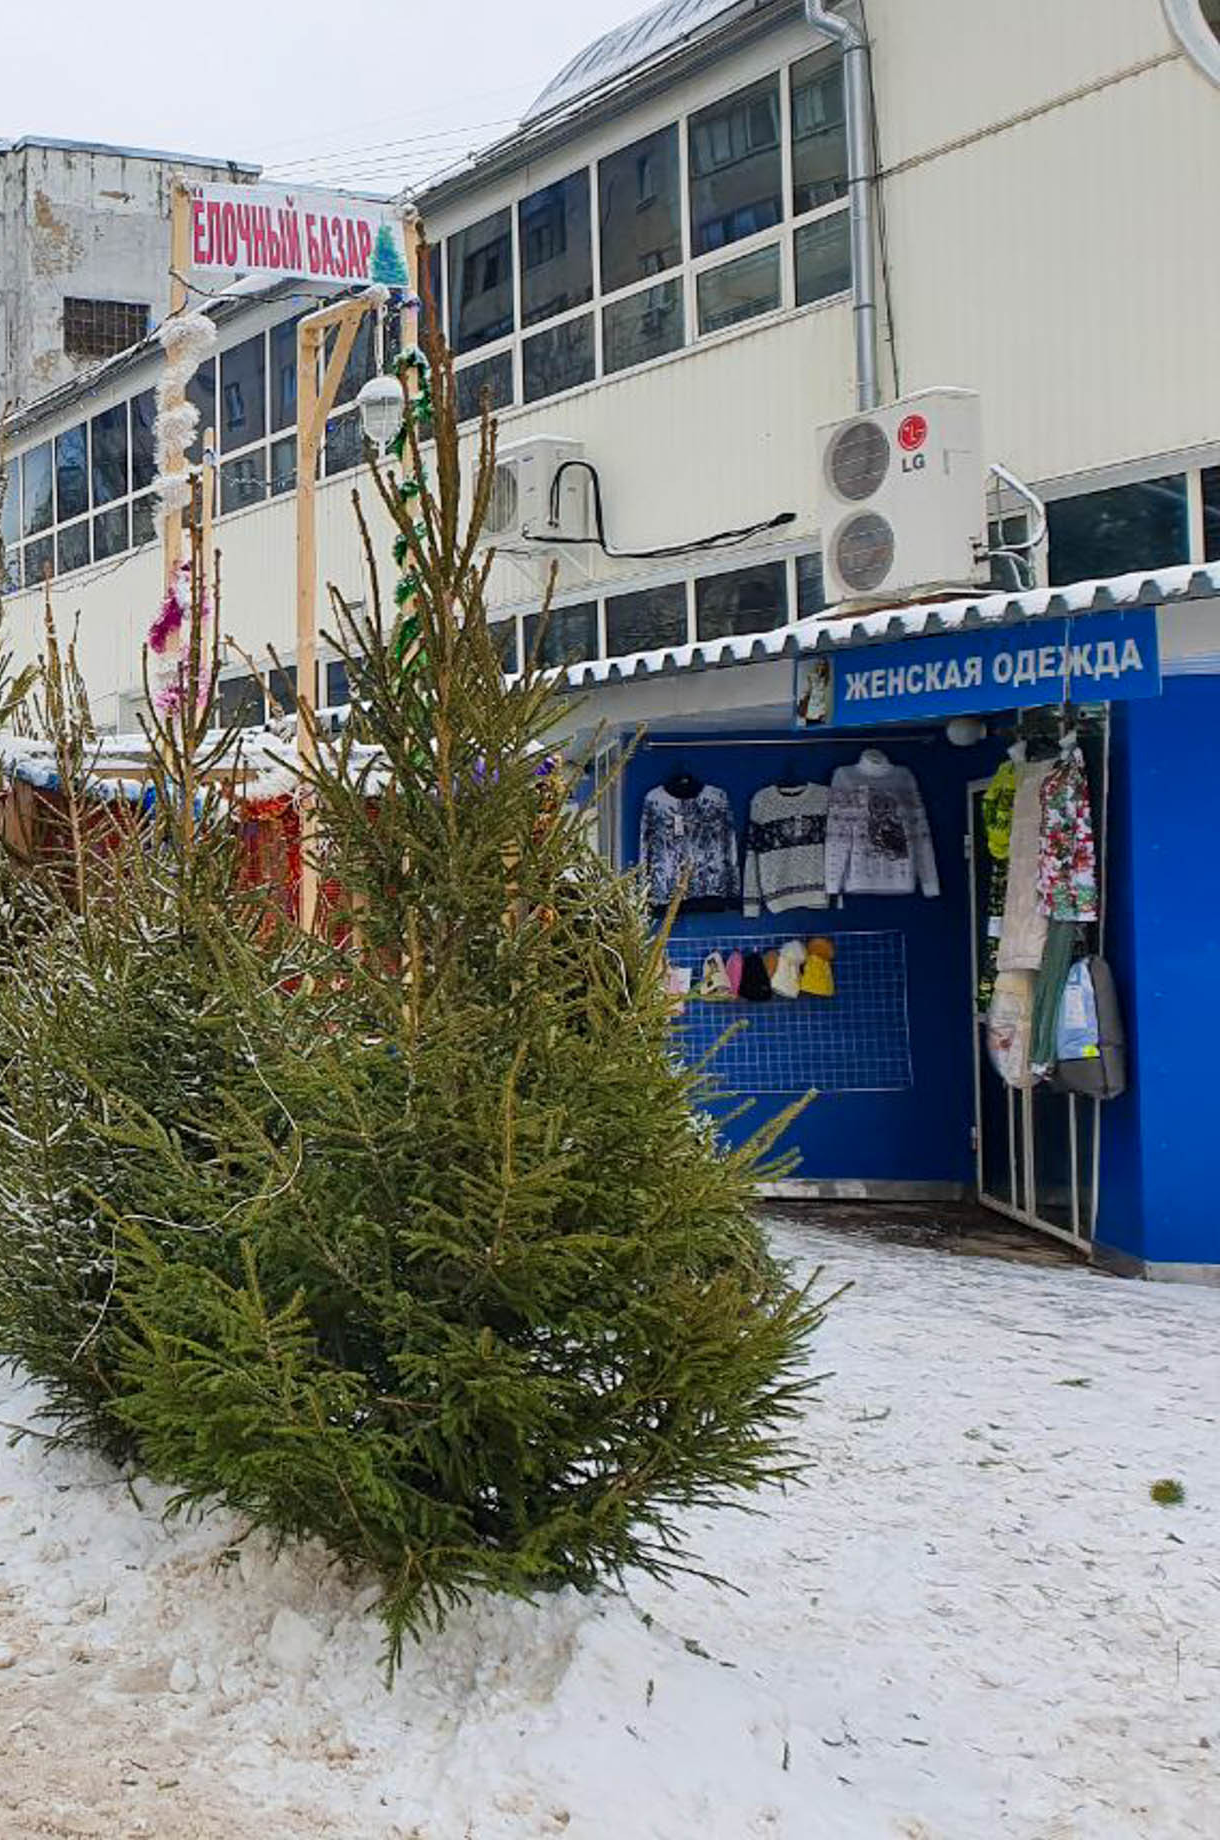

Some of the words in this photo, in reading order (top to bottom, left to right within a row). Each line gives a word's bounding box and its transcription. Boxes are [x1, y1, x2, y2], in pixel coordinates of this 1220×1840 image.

[193, 188, 302, 270] ЁЛОЧНЫЙ
[305, 213, 372, 279] БАЗАР
[902, 453, 926, 473] LG
[844, 656, 983, 701] ЖЕНСКАЯ
[992, 638, 1144, 688] ОДЕЖДА
